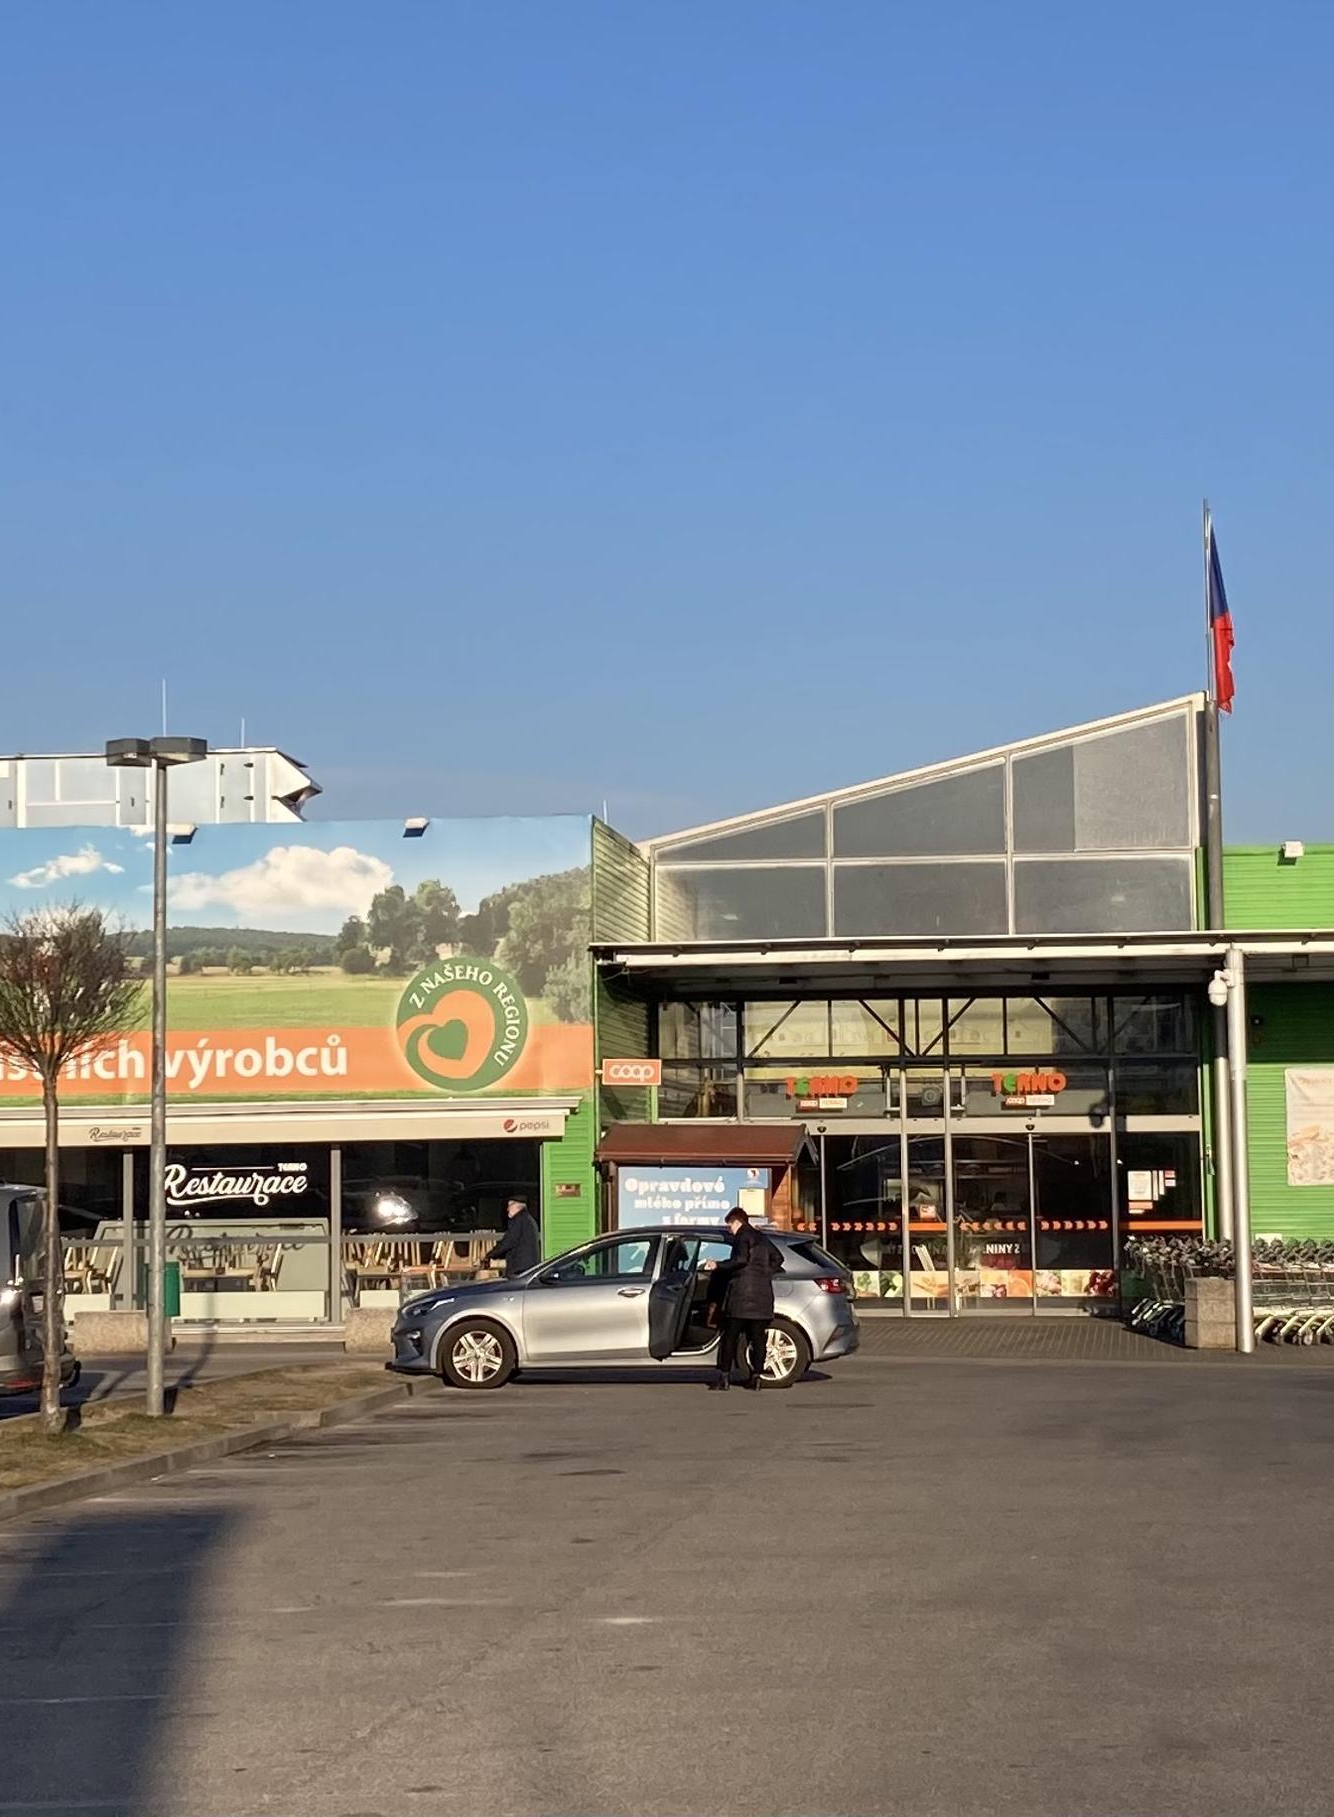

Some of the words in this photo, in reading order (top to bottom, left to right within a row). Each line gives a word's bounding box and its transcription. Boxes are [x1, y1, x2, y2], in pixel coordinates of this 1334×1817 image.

[409, 992, 425, 1008] Z
[420, 963, 493, 994] NAŠEHO
[493, 982, 520, 1067] REGIONU
[164, 1034, 348, 1090] výrobců
[609, 1064, 655, 1082] coop
[991, 1072, 1067, 1094] TERNO
[164, 1163, 308, 1206] Restaurace
[624, 1176, 725, 1194] Opravdové
